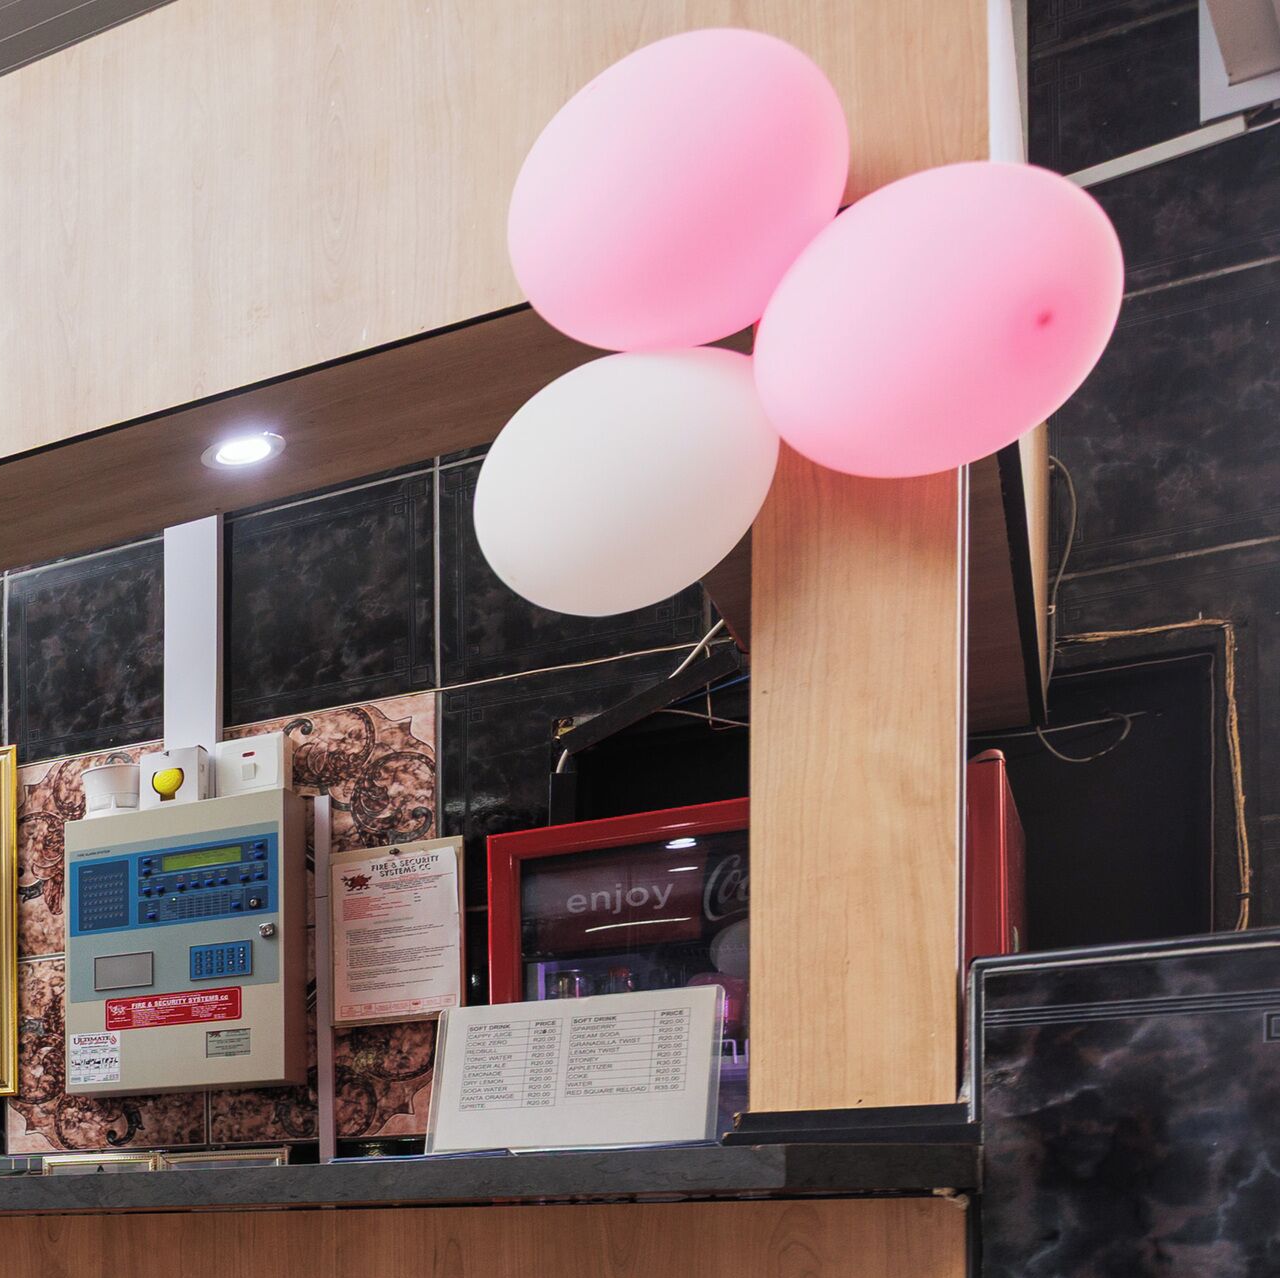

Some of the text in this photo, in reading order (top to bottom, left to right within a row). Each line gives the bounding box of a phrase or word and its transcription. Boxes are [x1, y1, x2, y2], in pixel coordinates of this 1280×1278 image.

[371, 863, 388, 871] FIRE
[400, 855, 439, 867] SECURITY
[380, 866, 416, 877] SYSTEMS
[566, 883, 673, 914] enjoy
[154, 998, 186, 1007] SECURITY
[188, 995, 218, 1003] SYSTEMS
[74, 1036, 110, 1044] ULTIMATE
[571, 1040, 616, 1048] GRANADILLA
